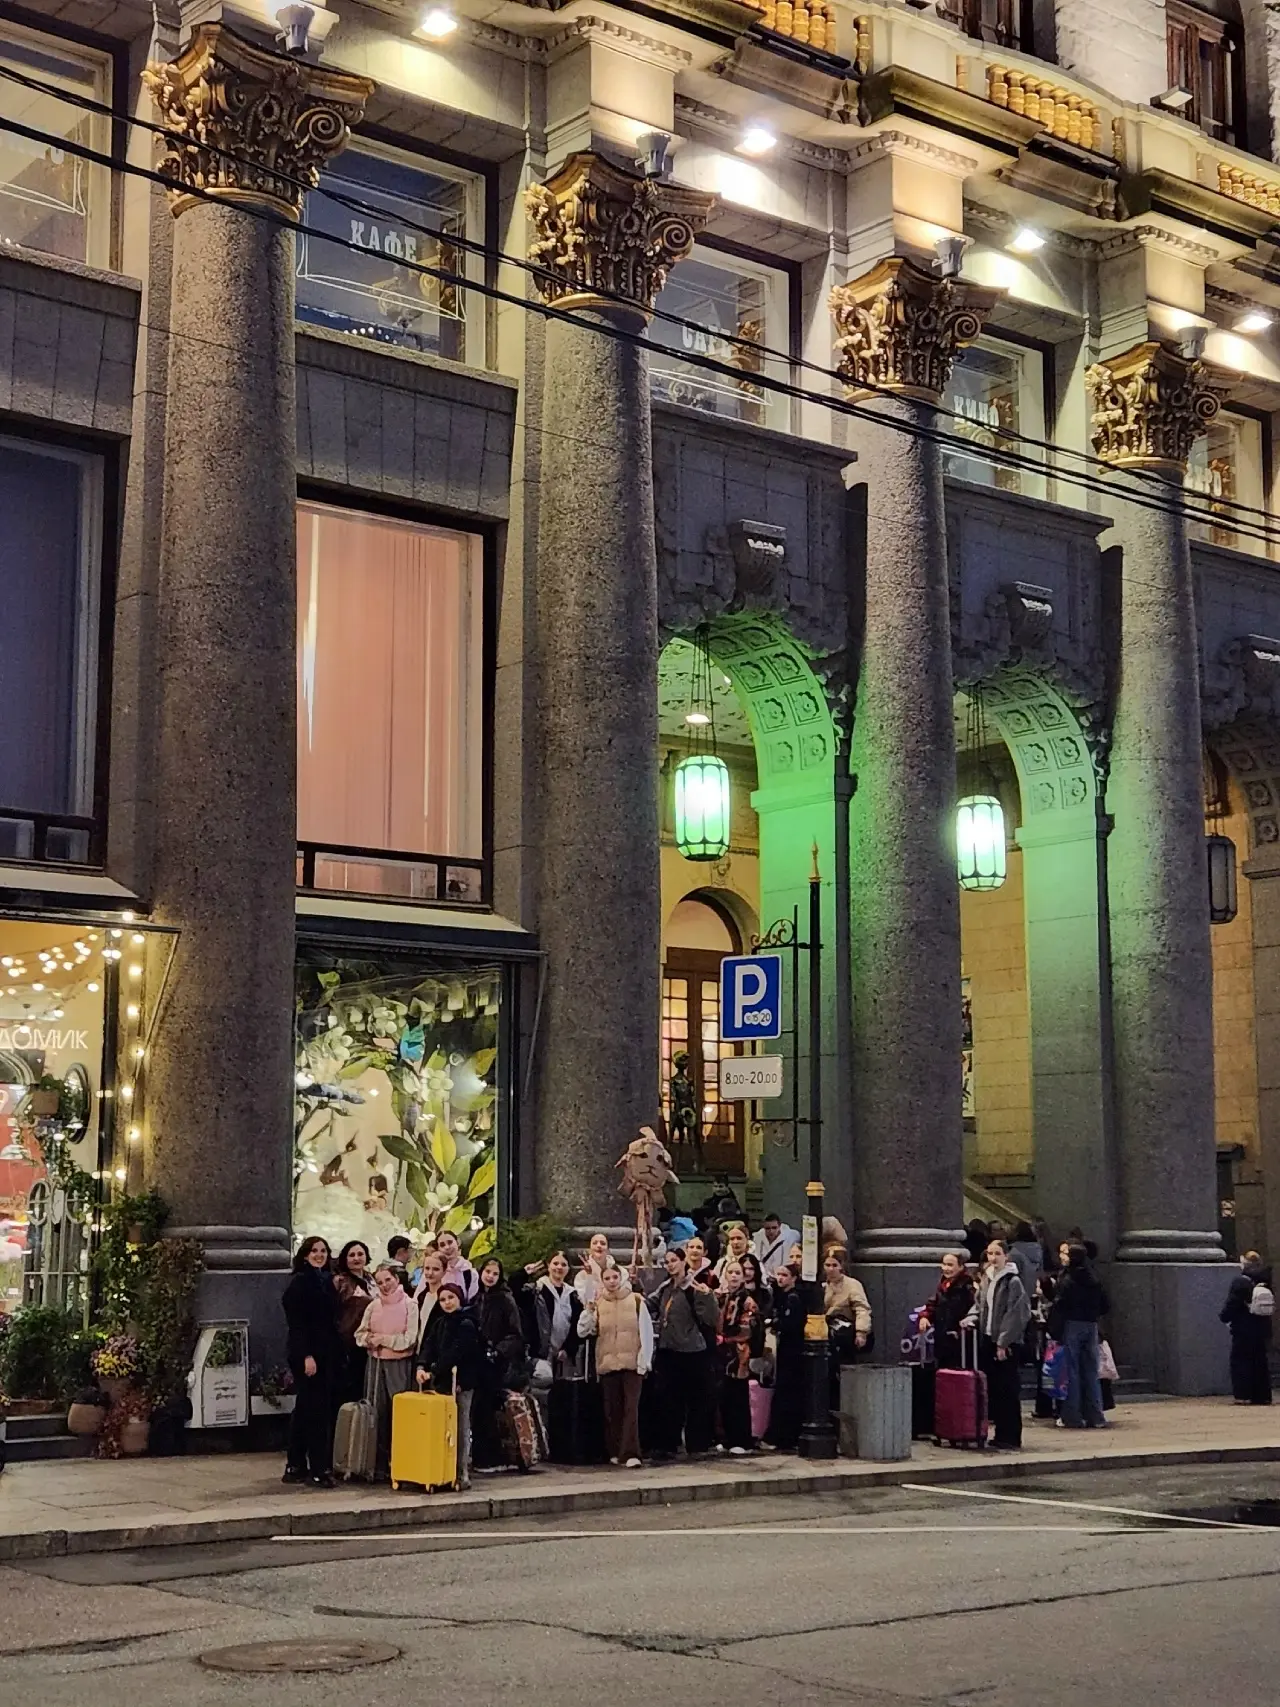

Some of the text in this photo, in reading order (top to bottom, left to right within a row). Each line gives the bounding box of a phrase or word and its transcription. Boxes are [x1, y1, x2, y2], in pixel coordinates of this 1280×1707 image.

[349, 219, 417, 264] КАФЕ
[953, 395, 1000, 432] КИНО
[734, 963, 768, 1028] P
[760, 1012, 771, 1022] 20
